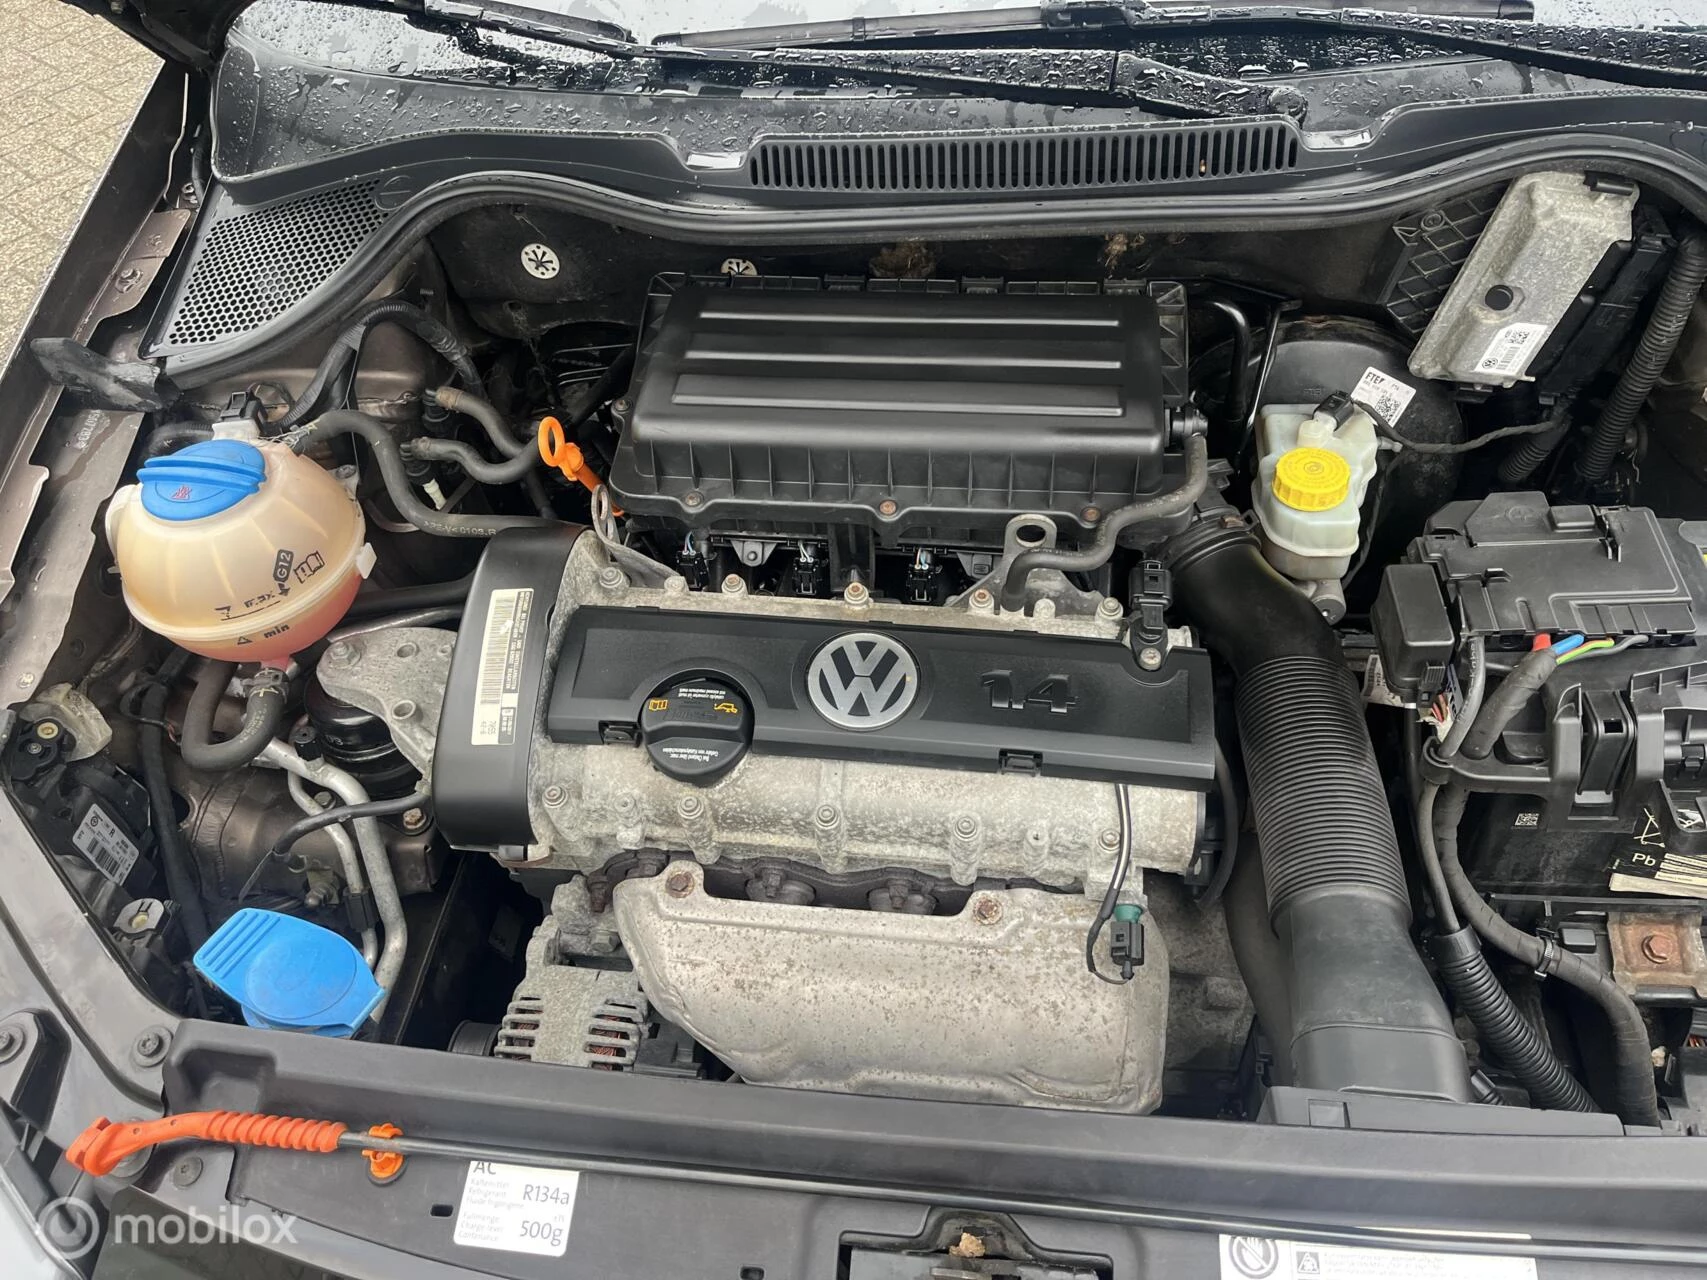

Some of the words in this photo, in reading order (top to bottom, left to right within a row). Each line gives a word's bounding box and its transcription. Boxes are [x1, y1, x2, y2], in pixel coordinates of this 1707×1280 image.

[276, 551, 291, 578] G12
[264, 624, 290, 639] min
[981, 669, 1079, 714] 1.4
[1632, 853, 1656, 867] Pb
[473, 1161, 496, 1175] AC
[522, 1184, 570, 1206] R134a
[520, 1220, 564, 1247] 500g
